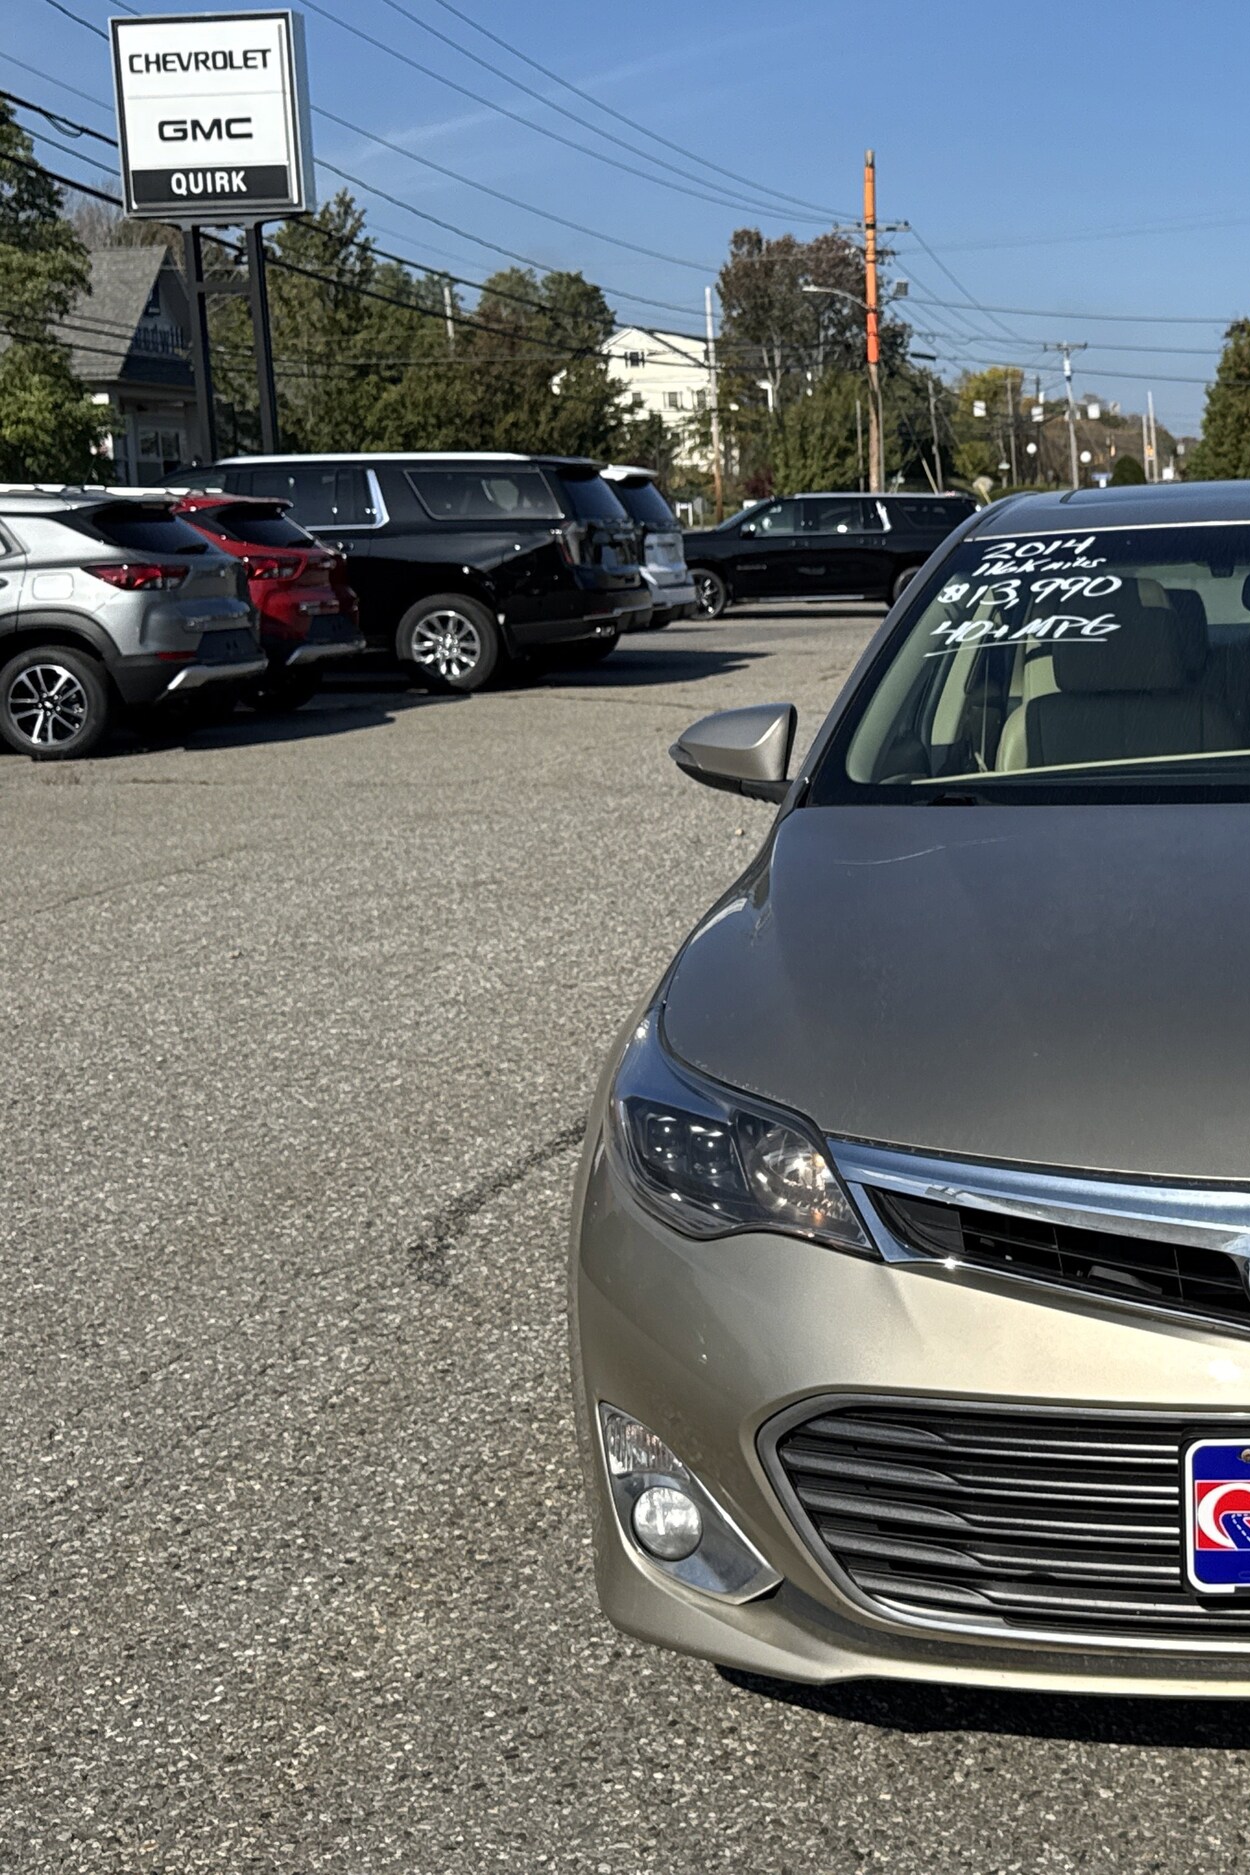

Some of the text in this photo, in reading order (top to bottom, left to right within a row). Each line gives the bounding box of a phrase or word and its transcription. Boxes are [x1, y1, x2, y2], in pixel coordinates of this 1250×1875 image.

[129, 48, 272, 74] CHEVROLET
[158, 117, 253, 141] GMC
[171, 170, 247, 196] QUIRK
[981, 536, 1096, 560] 2014
[937, 575, 1122, 610] $13,990
[930, 613, 1121, 645] 40+ MPG
